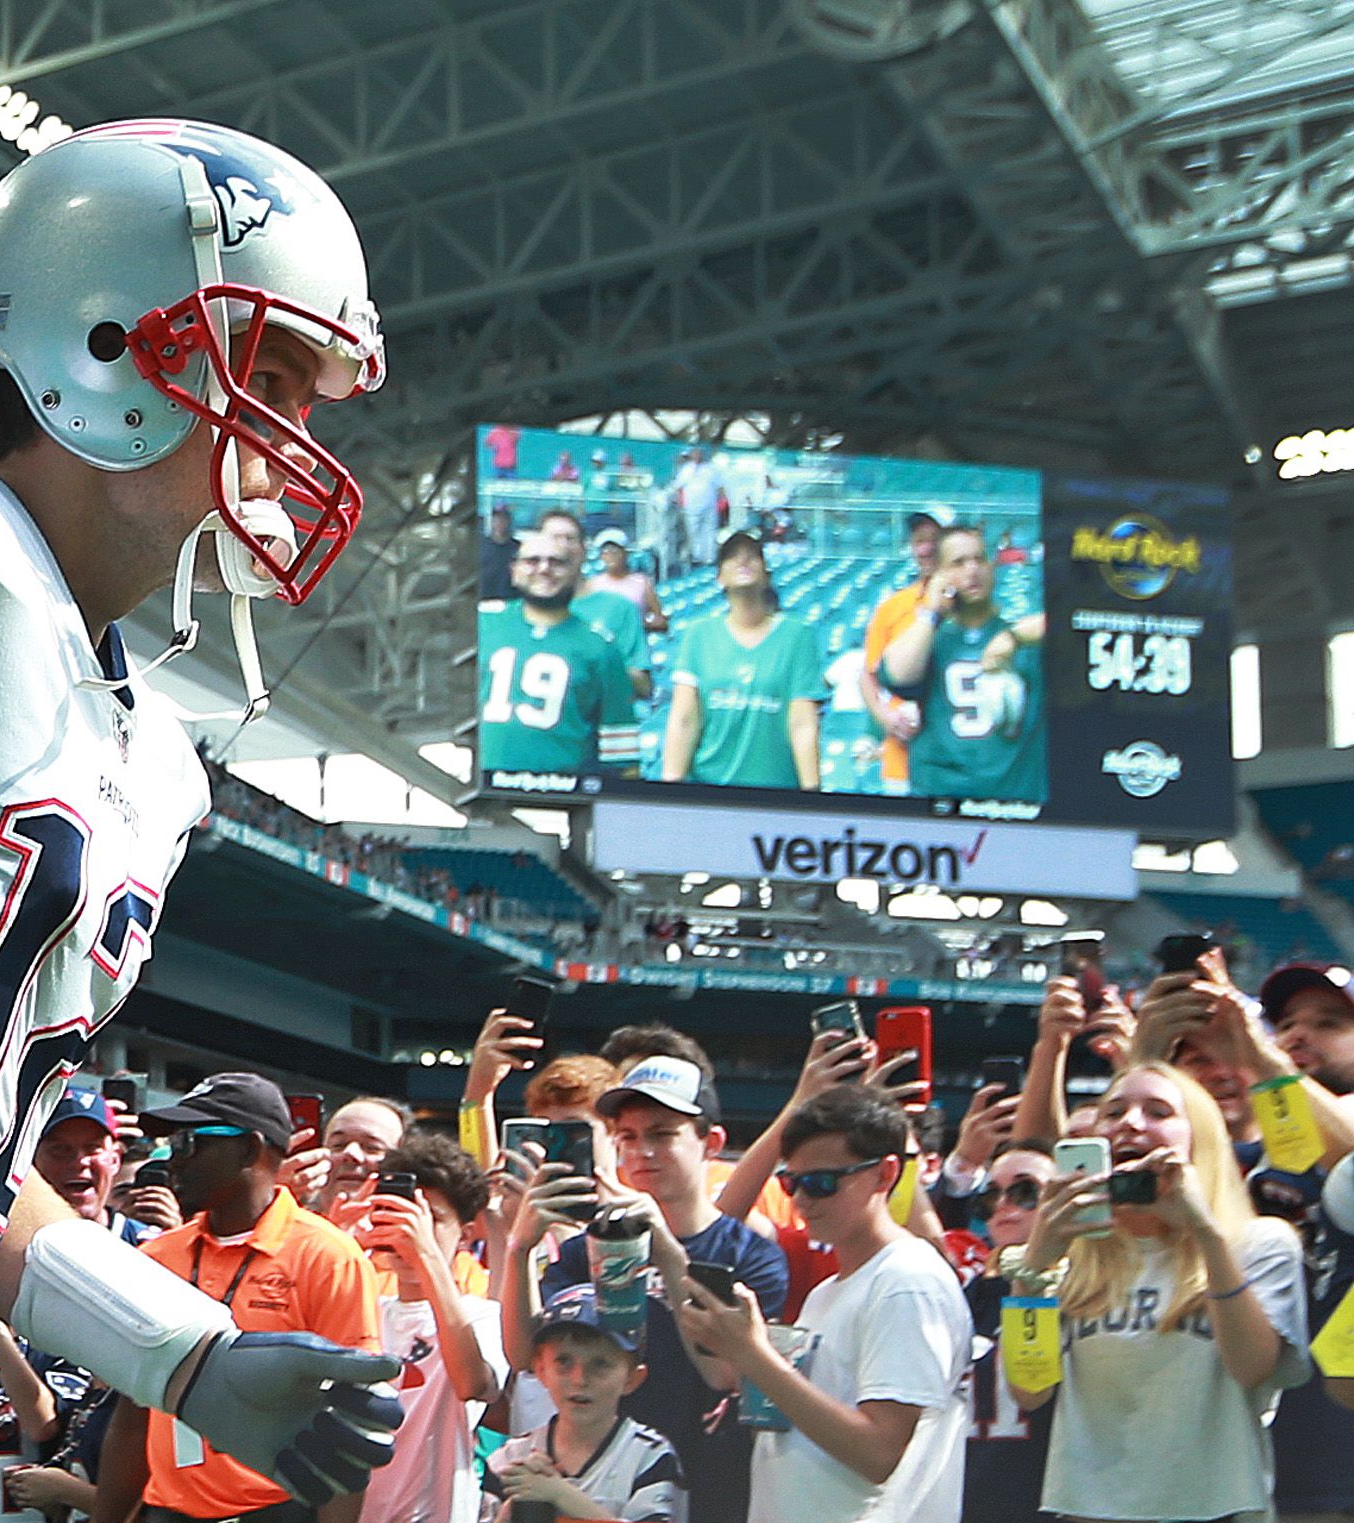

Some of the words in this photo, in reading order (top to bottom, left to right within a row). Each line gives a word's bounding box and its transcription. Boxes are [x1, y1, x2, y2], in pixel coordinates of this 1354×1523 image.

[482, 645, 570, 731] 19
[1087, 630, 1192, 694] 54:39
[752, 828, 960, 883] verizon
